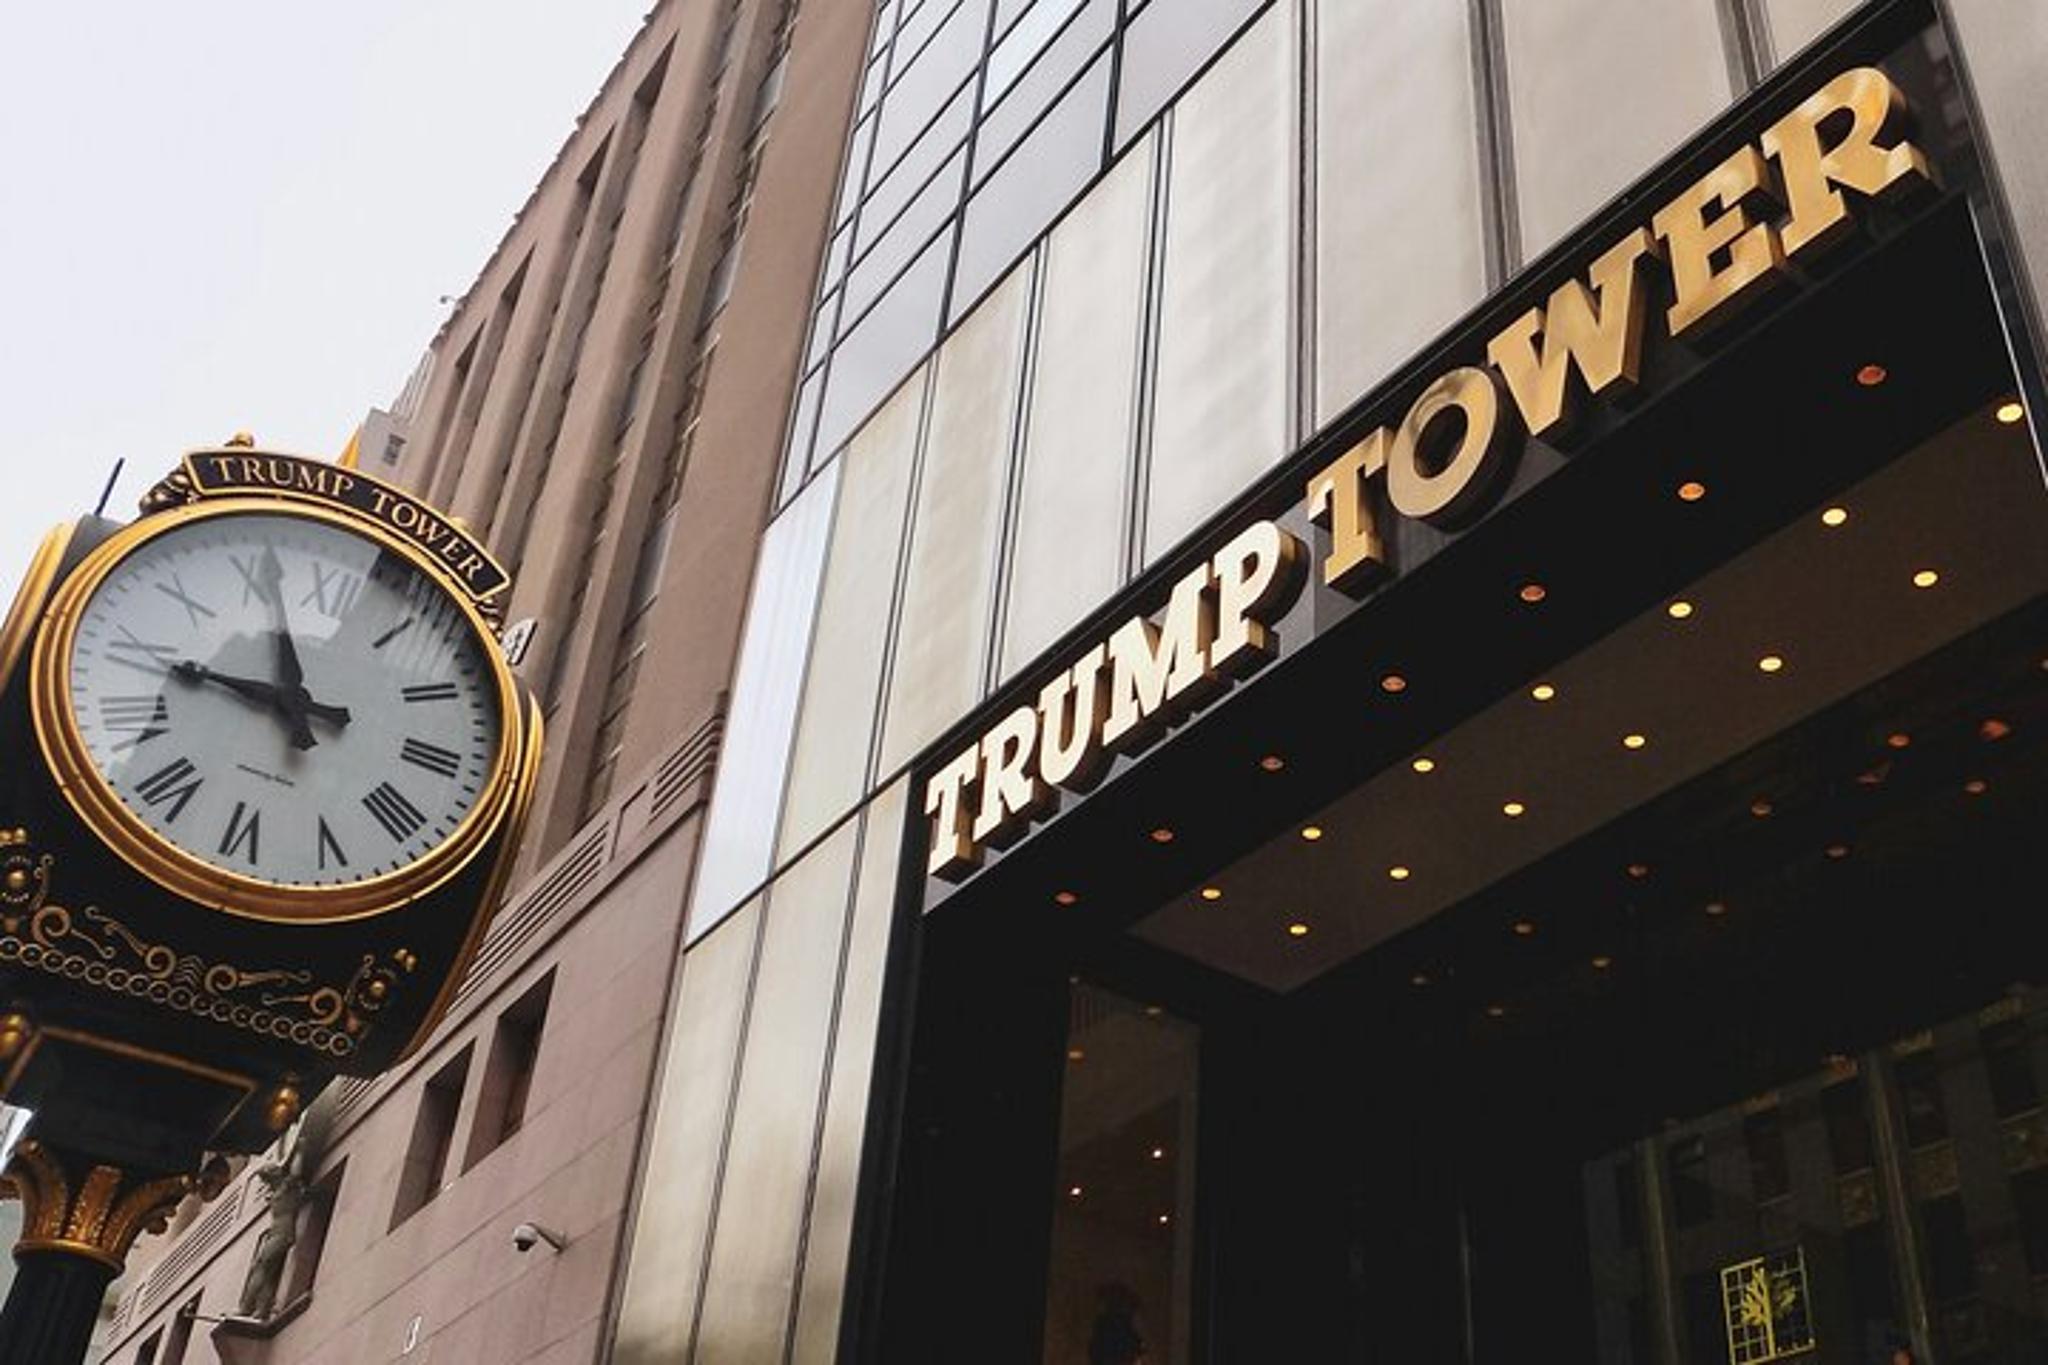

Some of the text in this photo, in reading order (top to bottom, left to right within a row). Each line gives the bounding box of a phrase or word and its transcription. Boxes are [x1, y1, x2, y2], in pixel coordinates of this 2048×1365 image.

[924, 66, 1918, 877] TRUMP TOWER
[210, 456, 484, 580] TRUMP TOWER
[99, 694, 171, 752] VIII
[401, 682, 459, 703] II
[400, 738, 461, 779] III
[134, 757, 204, 824] VII
[361, 781, 427, 843] IIII
[217, 801, 260, 866] VI
[318, 814, 348, 870] V
